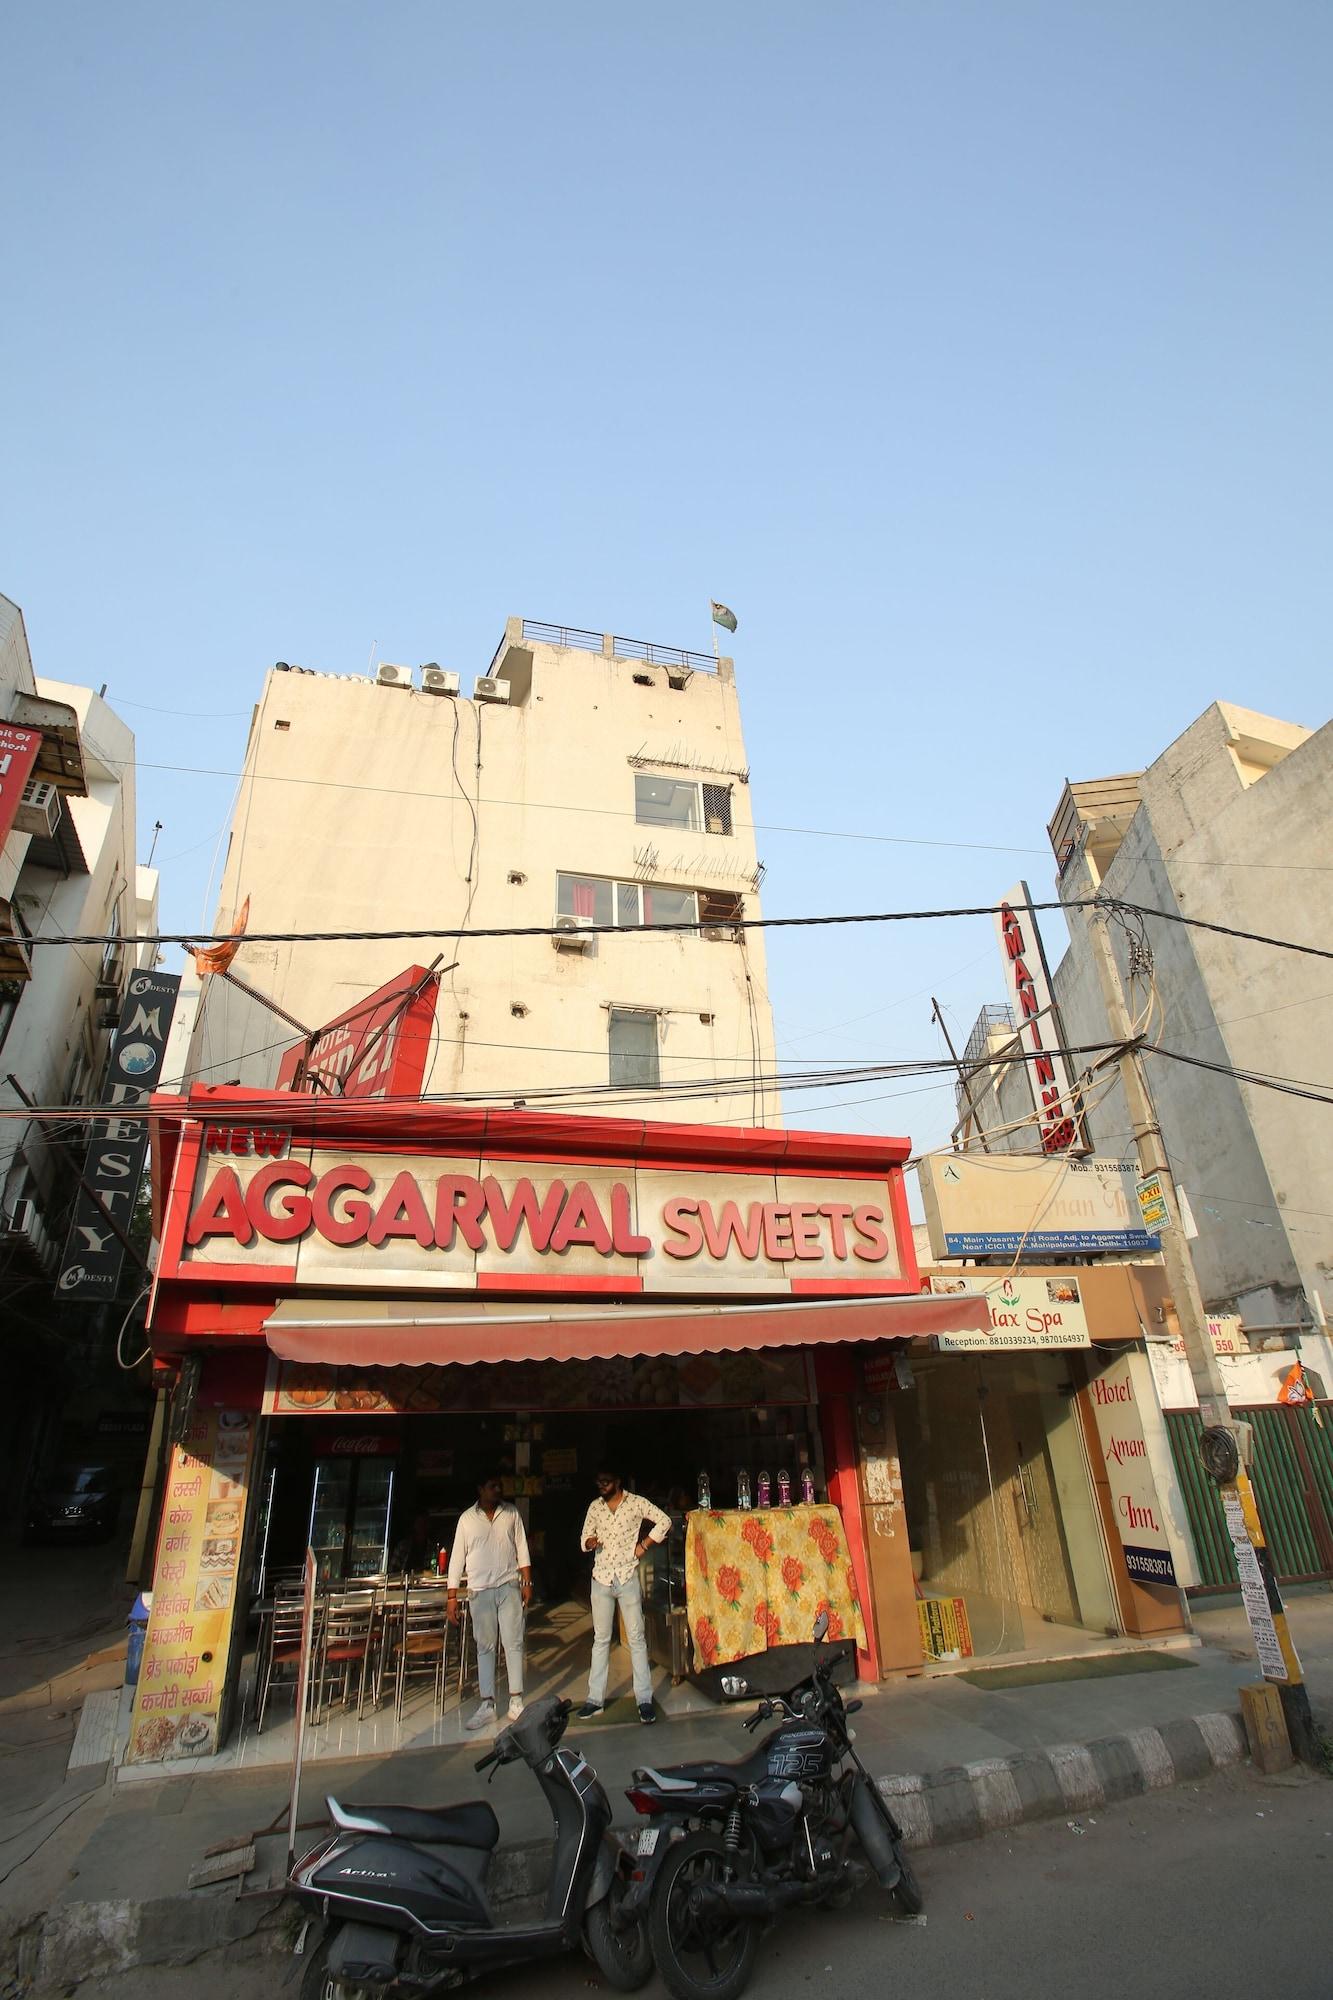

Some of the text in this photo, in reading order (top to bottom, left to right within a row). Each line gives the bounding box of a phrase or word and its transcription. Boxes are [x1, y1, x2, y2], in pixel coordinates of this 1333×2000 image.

[15, 733, 32, 742] Of
[1001, 901, 1064, 1121] AMAN INN
[206, 1124, 289, 1158] NEW
[186, 1159, 889, 1261] AGGARWAL SWEETS
[963, 1236, 984, 1244] Main
[986, 1235, 1015, 1243] Vasant
[1091, 1233, 1127, 1242] Aggarwal
[1025, 1308, 1063, 1334] Spa
[944, 1337, 987, 1347] Reception:
[1040, 1334, 1085, 1345] 9870164937
[1091, 1376, 1132, 1405] Hotel
[1106, 1435, 1147, 1466] Aman
[169, 1504, 194, 1526] केक
[165, 1530, 193, 1553] बर्गर
[1126, 1554, 1173, 1577] 9315583874
[770, 1753, 824, 1777] 125
